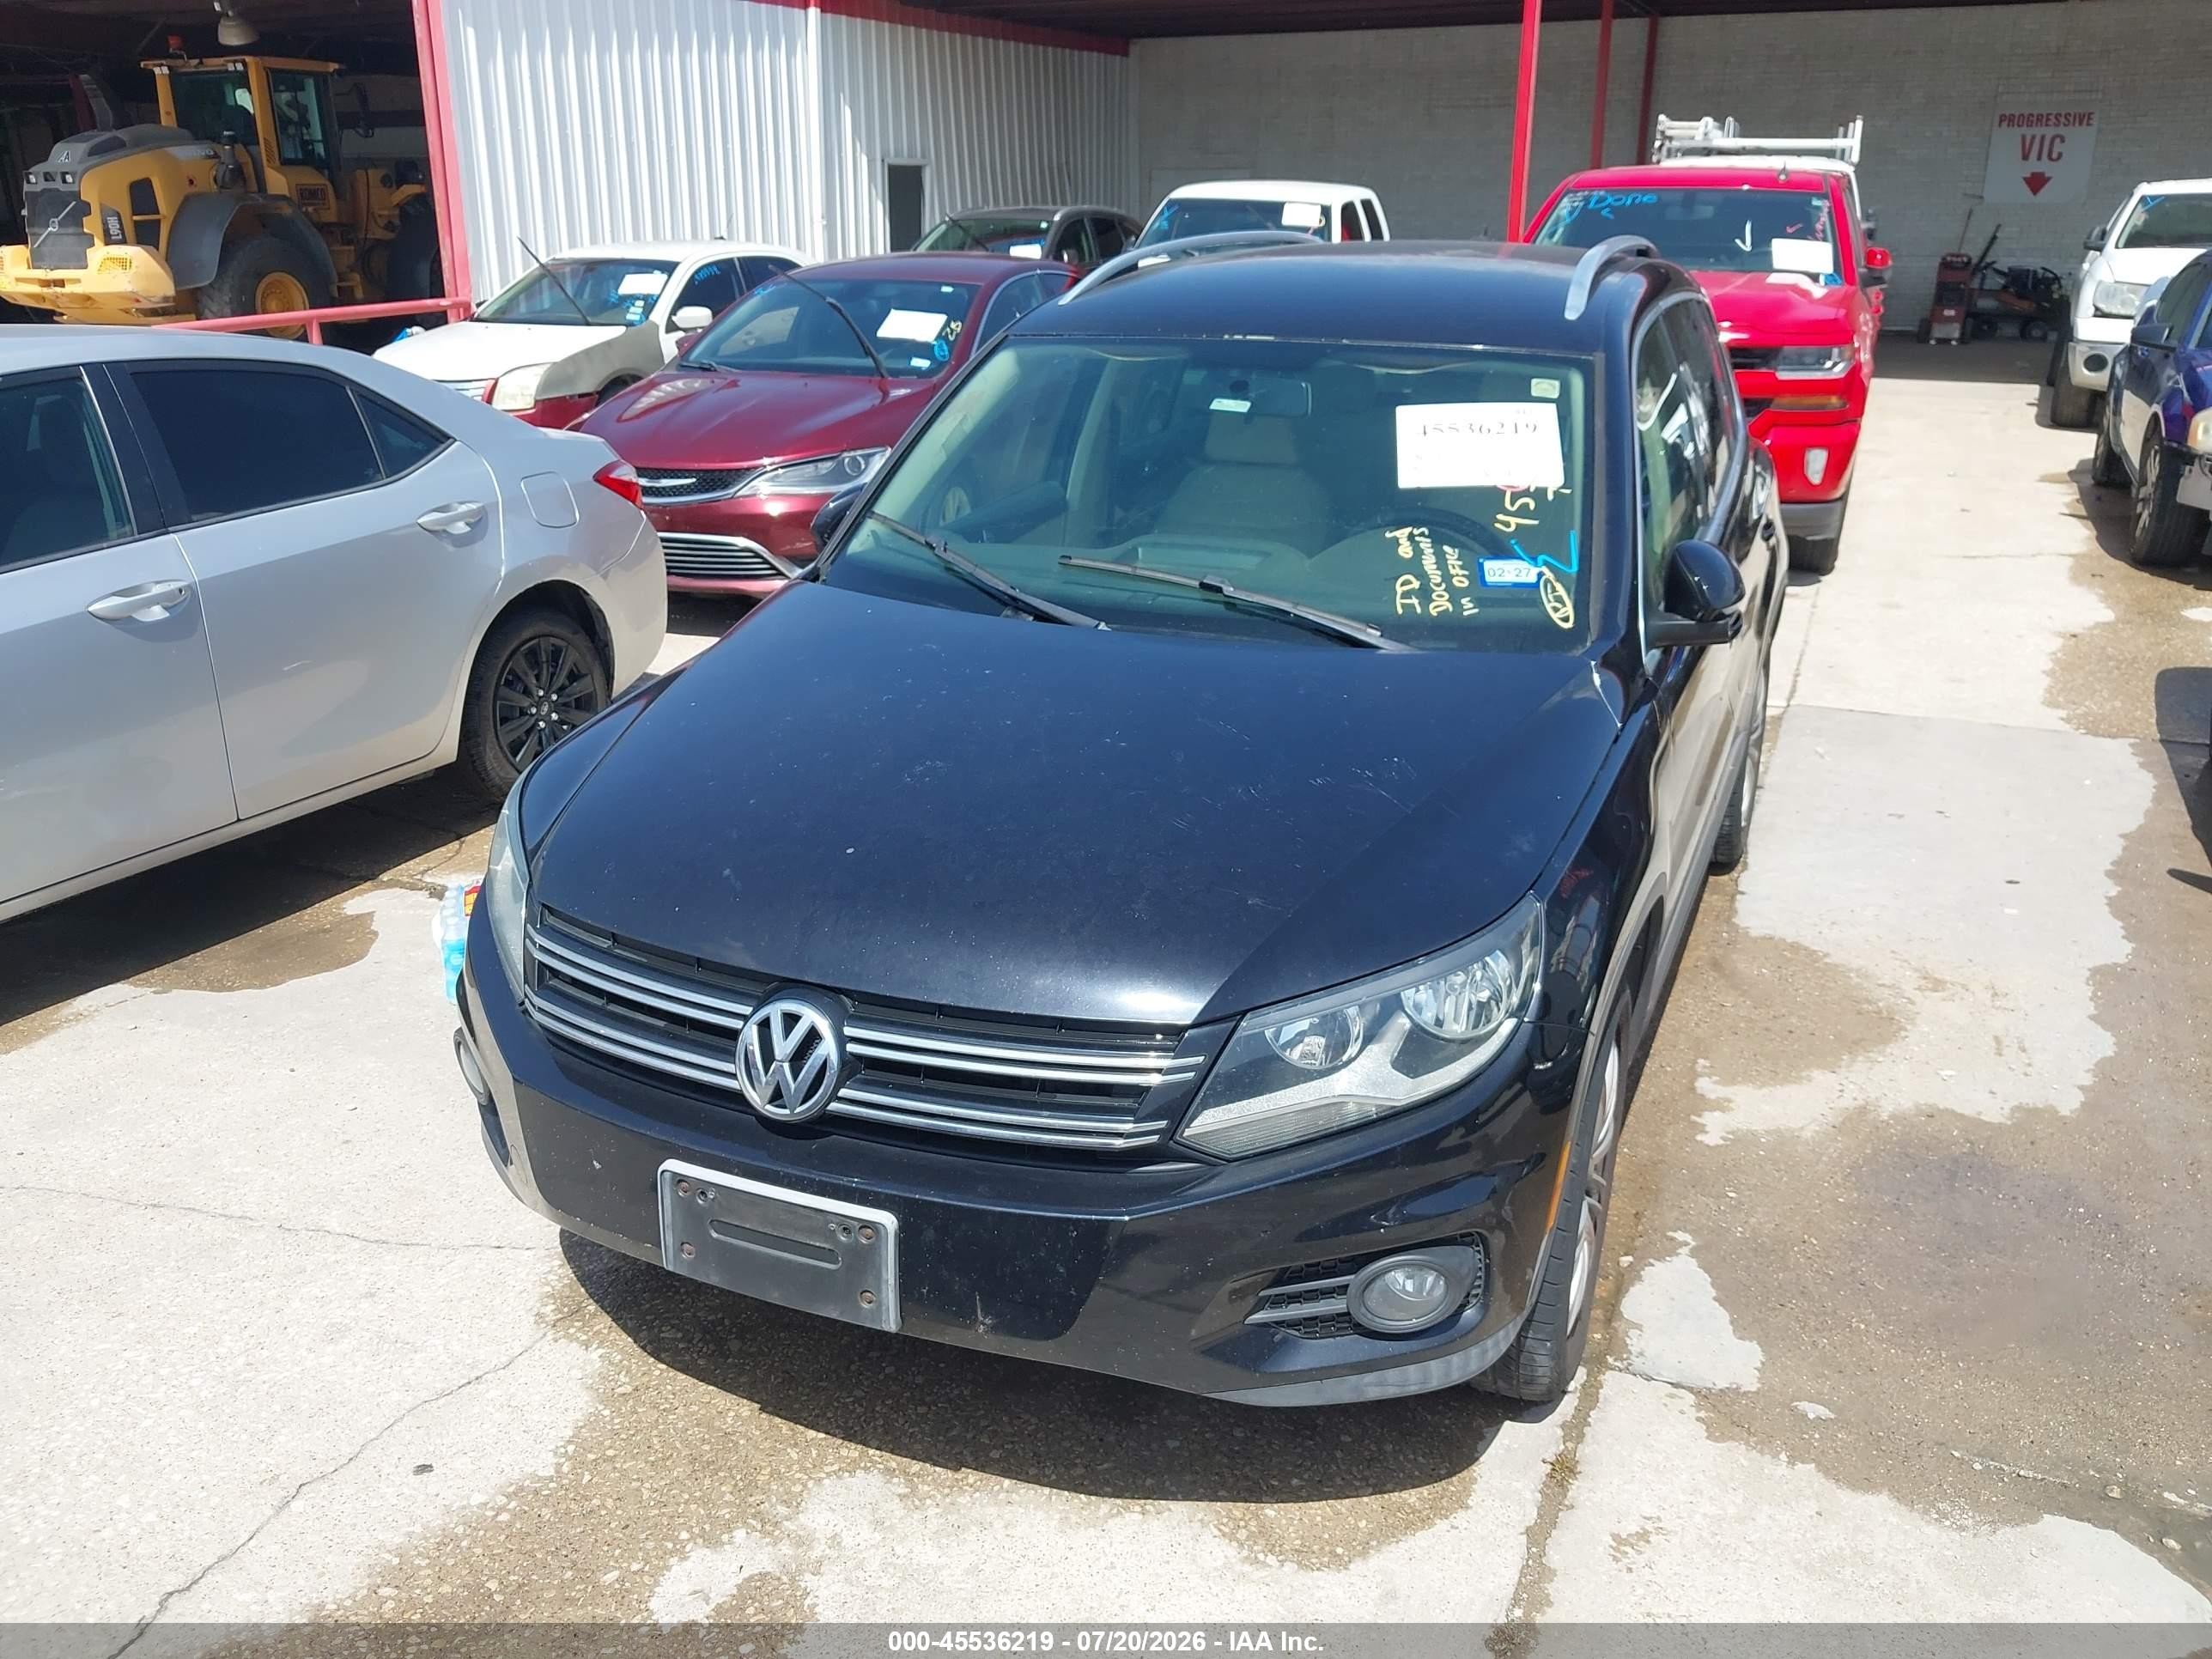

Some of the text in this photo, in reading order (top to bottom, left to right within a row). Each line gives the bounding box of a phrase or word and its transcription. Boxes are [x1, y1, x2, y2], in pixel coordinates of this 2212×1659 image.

[1998, 112, 2095, 128] PROGRESSIVE
[2021, 133, 2066, 162] VIC
[1385, 526, 1422, 615] ID and
[744, 1006, 830, 1115] VW
